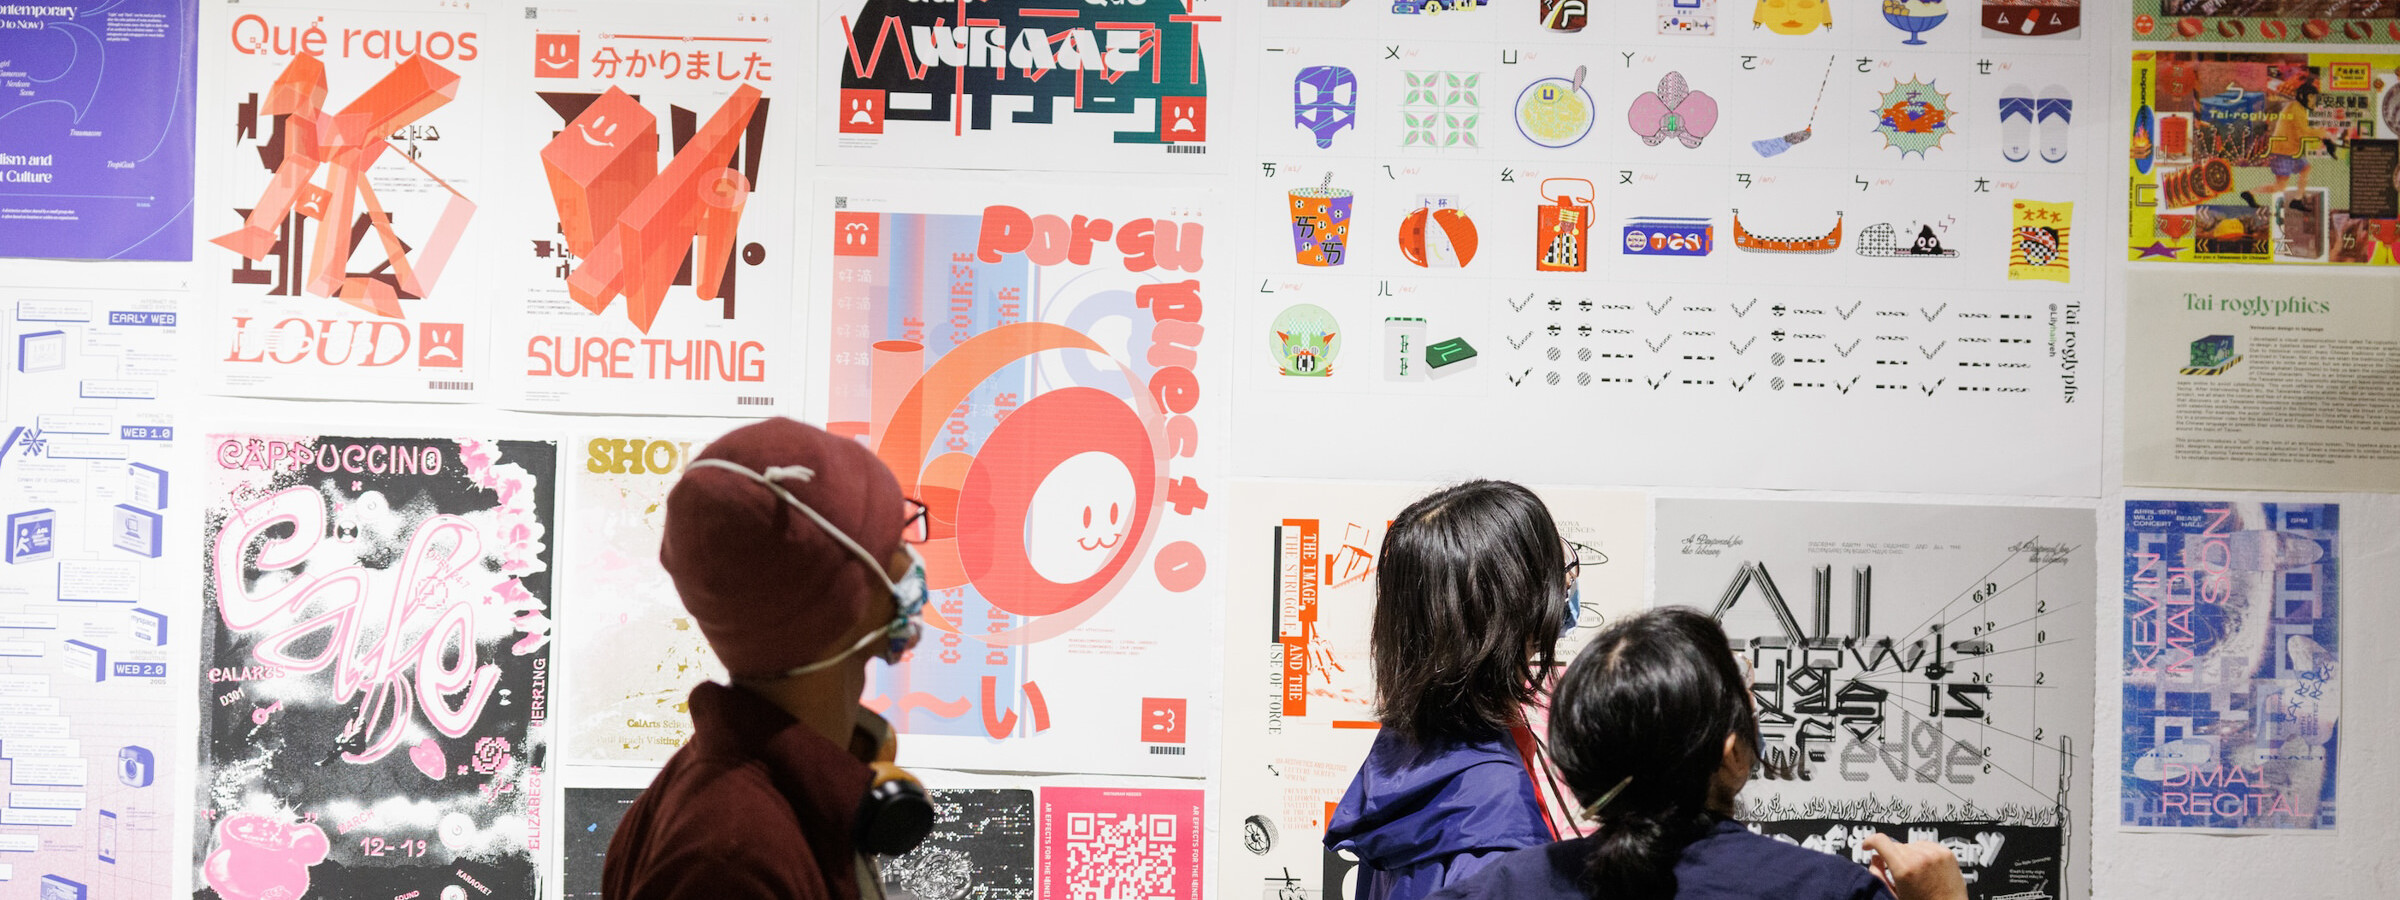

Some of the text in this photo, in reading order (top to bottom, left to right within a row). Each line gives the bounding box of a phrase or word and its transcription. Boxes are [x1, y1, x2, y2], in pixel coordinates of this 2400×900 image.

[18, 20, 44, 30] Now)
[232, 14, 327, 57] Qué
[591, 47, 772, 81] 分かりました
[28, 153, 53, 167] and
[6, 170, 53, 184] Culture
[950, 252, 974, 345] COURSE
[2183, 293, 2330, 317] Tai roglyphics
[112, 313, 175, 325] EARLY WEB
[902, 317, 925, 342] OF
[223, 316, 411, 368] LOUD
[527, 335, 765, 382] SURE THING
[123, 427, 170, 439] WEB 1.0
[217, 440, 442, 475] CAPPUCCINO
[1284, 534, 1299, 559] THE
[1302, 533, 1317, 560] THE
[2201, 508, 2231, 606] SON
[2132, 552, 2161, 674] KEVIN
[116, 664, 164, 674] WEB 2.0
[1288, 643, 1303, 701] AND THE
[219, 687, 245, 707] D301
[531, 657, 546, 727] HERRING
[1268, 643, 1283, 735] USE OF FORCE
[627, 719, 661, 729] CalArts
[646, 736, 680, 747] Visiting
[2162, 763, 2271, 788] DMA1
[1045, 803, 1052, 813] AR
[1192, 805, 1199, 816] AR
[2162, 793, 2315, 817] RECITAL
[338, 808, 376, 835] MARCH
